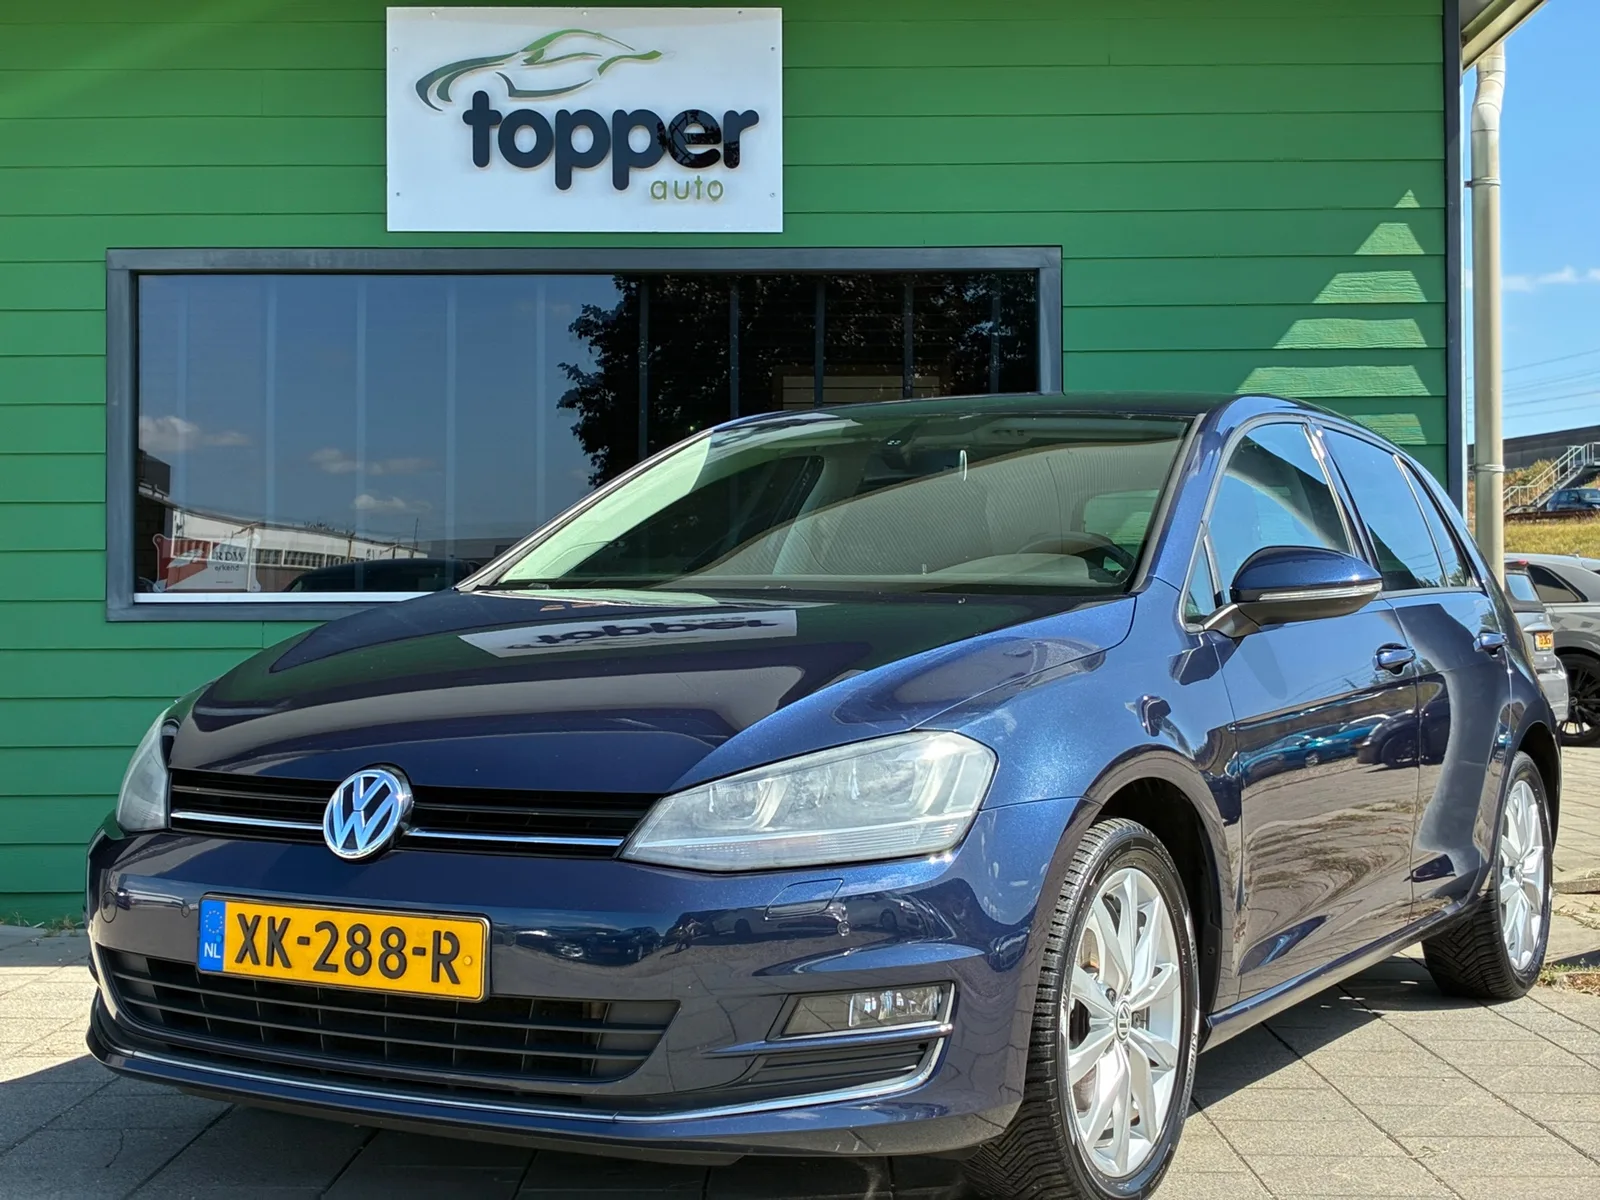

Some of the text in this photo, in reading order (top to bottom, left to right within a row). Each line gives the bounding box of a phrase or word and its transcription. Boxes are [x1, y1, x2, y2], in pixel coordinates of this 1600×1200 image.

[462, 90, 760, 191] topper
[650, 175, 724, 201] auto
[214, 551, 247, 561] RDW
[204, 942, 221, 959] NL
[234, 913, 461, 984] XK-288-R
